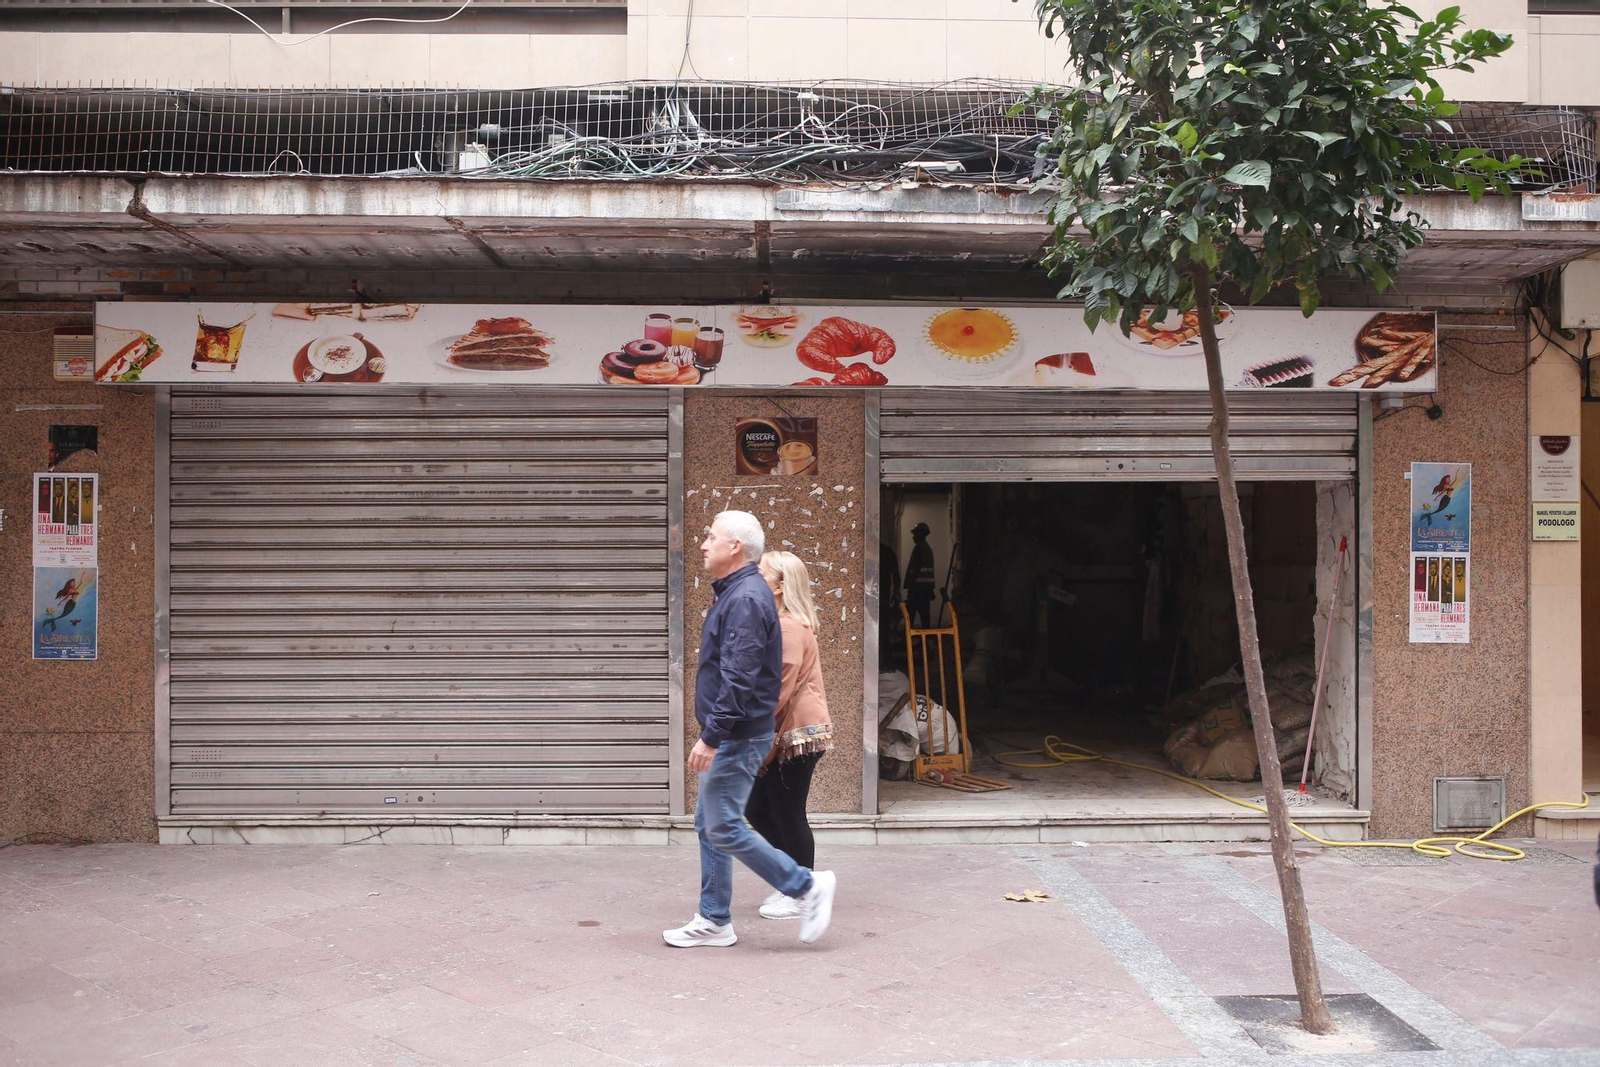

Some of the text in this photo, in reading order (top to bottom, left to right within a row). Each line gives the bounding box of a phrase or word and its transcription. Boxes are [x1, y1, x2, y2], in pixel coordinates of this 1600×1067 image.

[38, 513, 51, 524] UNA
[38, 525, 94, 536] HERMANA PARA TRES
[66, 536, 94, 546] HERMANOS
[1414, 592, 1426, 602] UNA
[1414, 603, 1466, 613] HERMANA PARA TRES
[1440, 613, 1466, 624] HERMANOS
